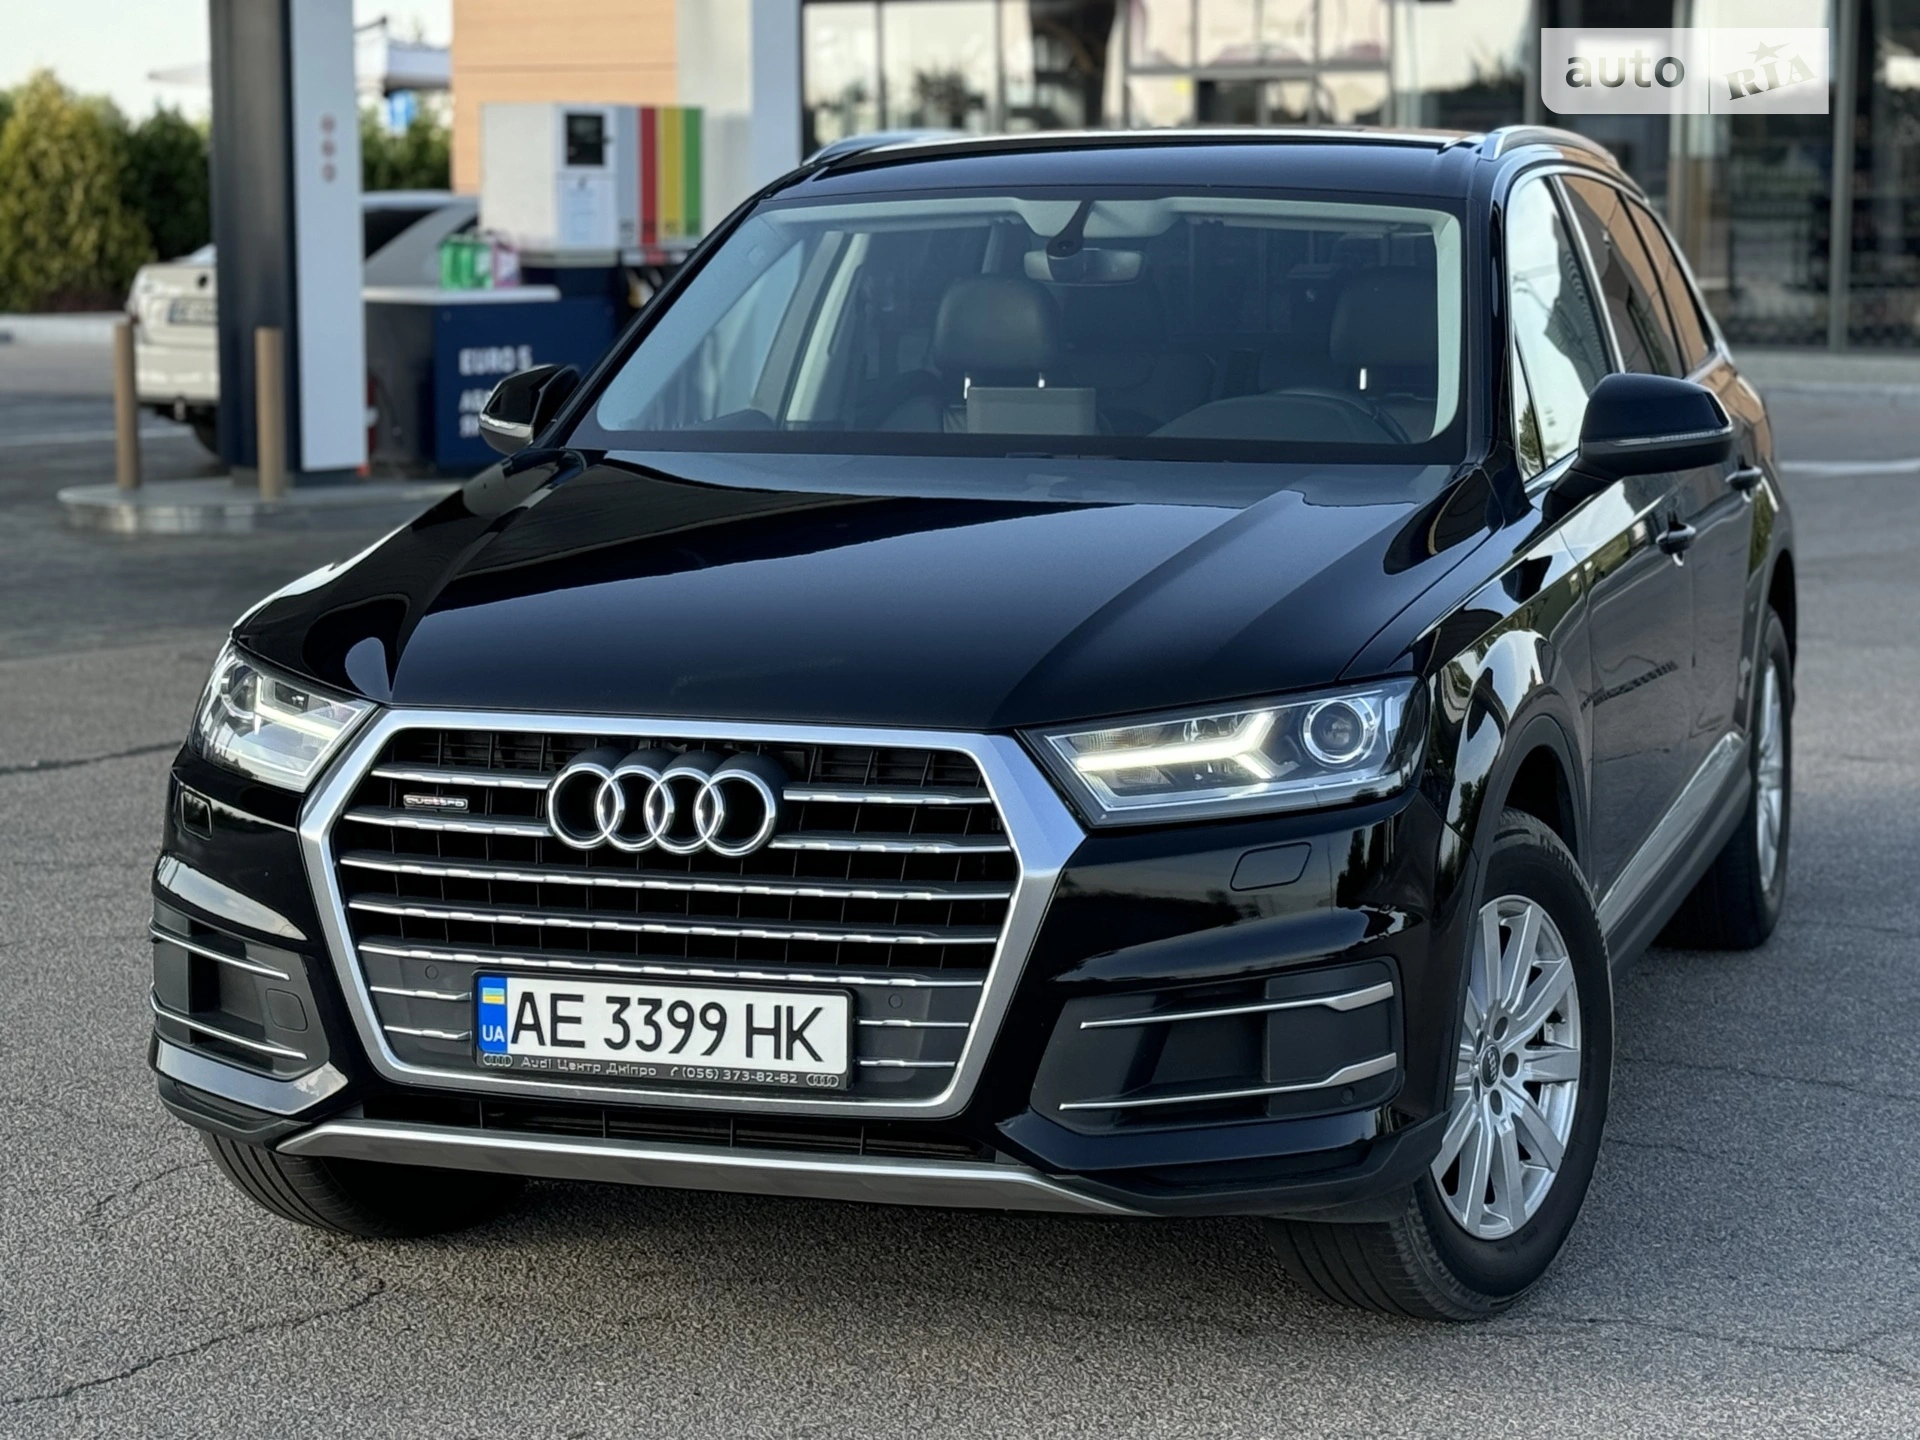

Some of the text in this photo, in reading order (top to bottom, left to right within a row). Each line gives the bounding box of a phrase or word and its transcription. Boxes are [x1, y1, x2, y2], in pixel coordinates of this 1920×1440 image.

[459, 347, 516, 376] EURO
[482, 1024, 505, 1043] UA
[510, 990, 825, 1062] AE 3399 HK
[520, 1056, 798, 1084] Audi Центр Дніпро (056) 373-82-82
